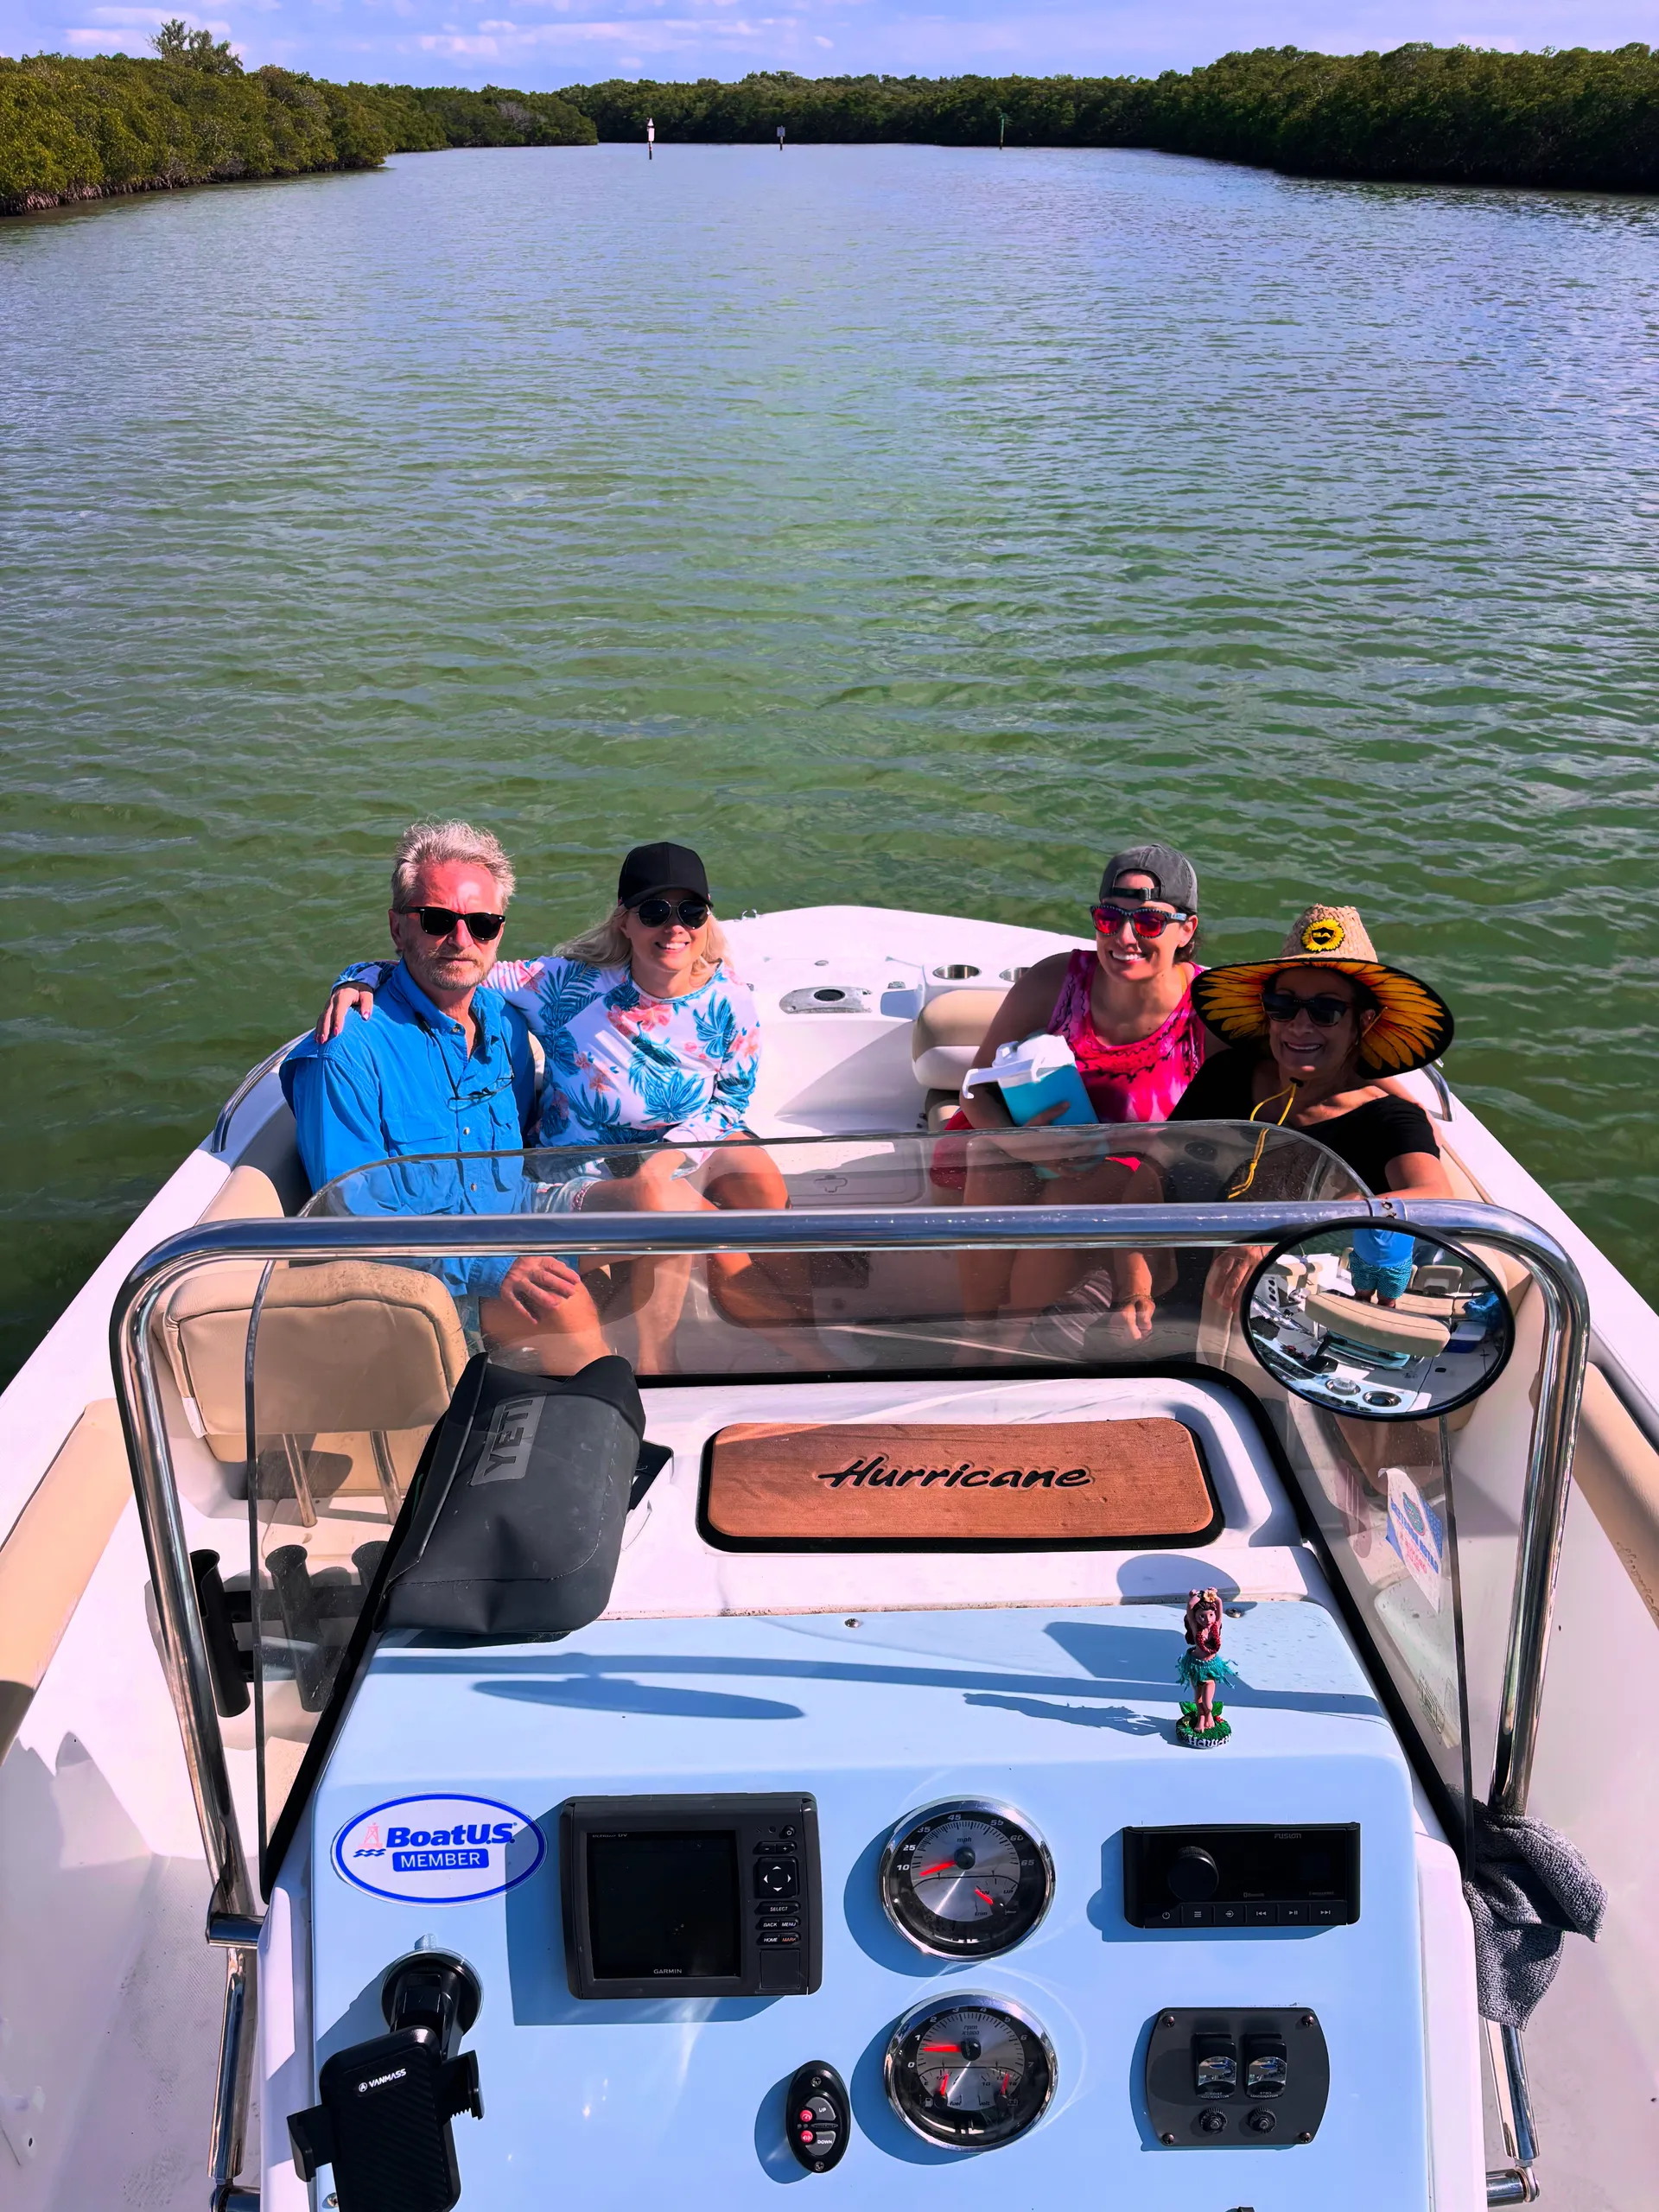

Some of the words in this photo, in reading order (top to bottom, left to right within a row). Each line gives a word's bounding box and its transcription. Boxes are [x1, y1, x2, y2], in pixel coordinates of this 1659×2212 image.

[483, 1400, 533, 1477] YETI
[818, 1456, 1090, 1488] Hurricane
[400, 1852, 480, 1869] MEMBER
[369, 2069, 407, 2088] VANMASS
